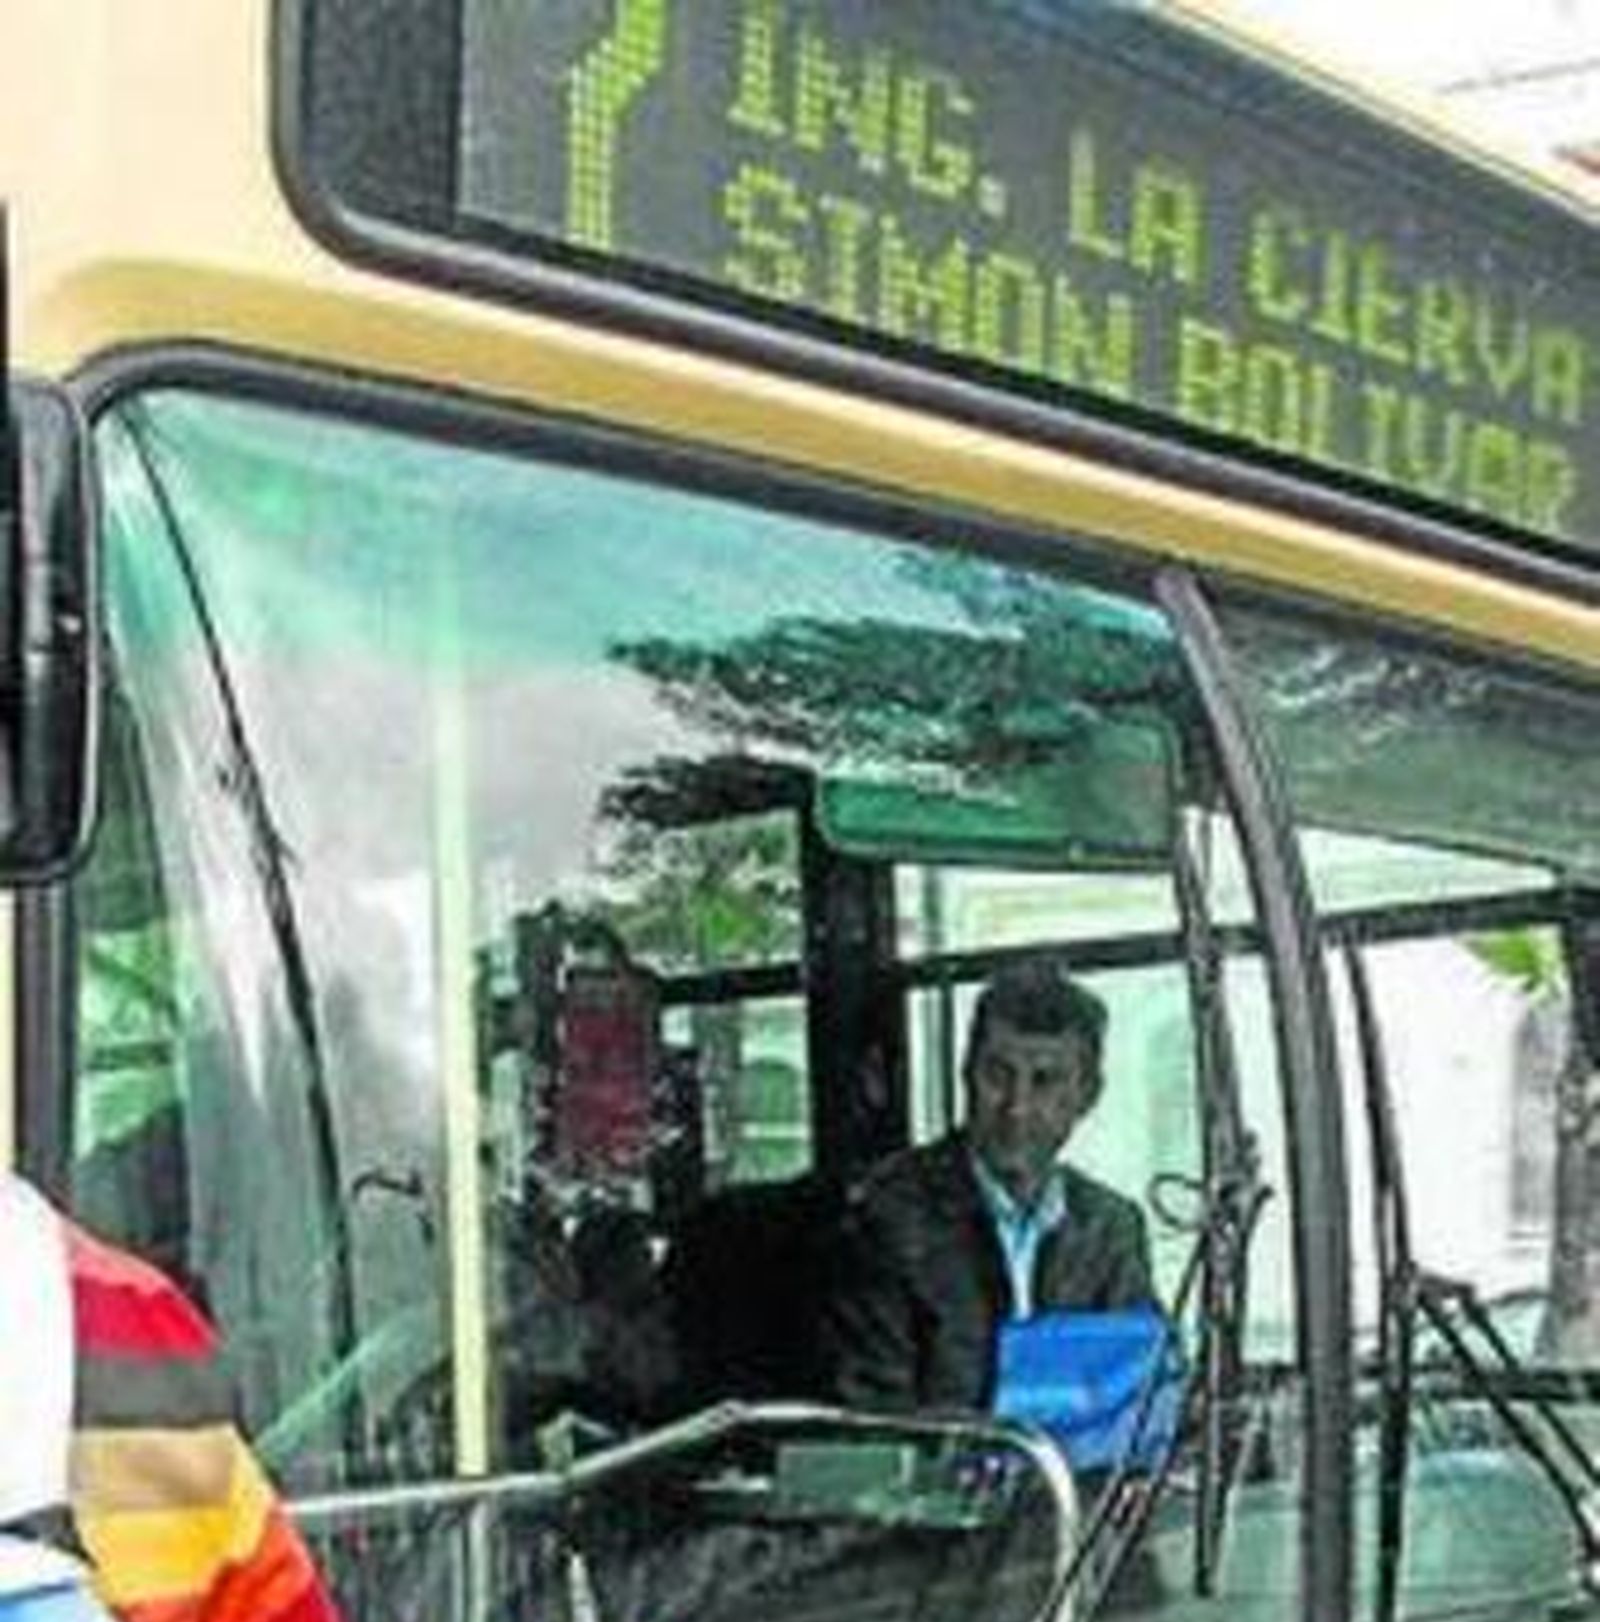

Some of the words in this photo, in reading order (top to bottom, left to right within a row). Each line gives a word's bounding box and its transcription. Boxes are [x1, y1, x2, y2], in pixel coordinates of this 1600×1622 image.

[722, 160, 1134, 398] SIMON
[1177, 316, 1576, 532] BOLIVAR
[727, 0, 1006, 216] ING.
[1068, 128, 1200, 287] LA
[1248, 208, 1586, 425] CIERVA
